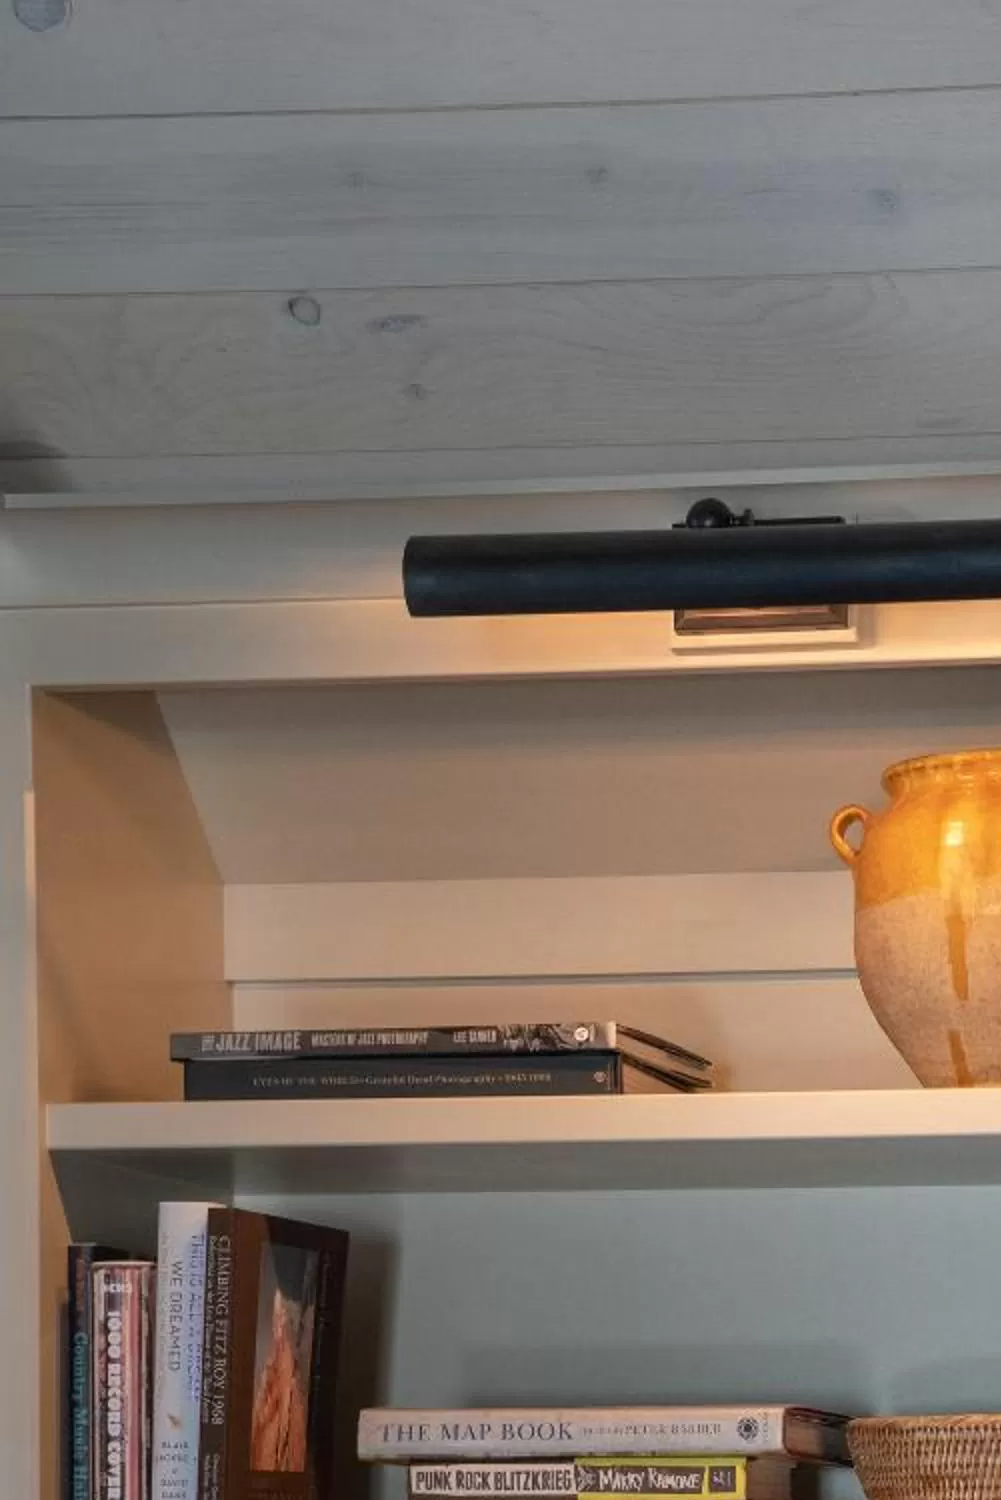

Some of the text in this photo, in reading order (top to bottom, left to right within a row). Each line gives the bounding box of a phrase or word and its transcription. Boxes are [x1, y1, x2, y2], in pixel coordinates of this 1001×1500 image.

[215, 1033, 252, 1052] JAZZ
[255, 1031, 302, 1052] IMAGE
[106, 1311, 122, 1360] 1000
[168, 1261, 183, 1372] WE DREAMED
[211, 1235, 232, 1425] CLIMBING FITZ ROY 1968
[71, 1331, 89, 1403] Country
[106, 1363, 122, 1438] RECORD
[72, 1407, 88, 1460] Music
[382, 1423, 433, 1443] THE
[440, 1423, 492, 1442] MAP
[501, 1422, 573, 1442] BOOK
[416, 1469, 572, 1492] PUNK ROCK BLITZKRIEG
